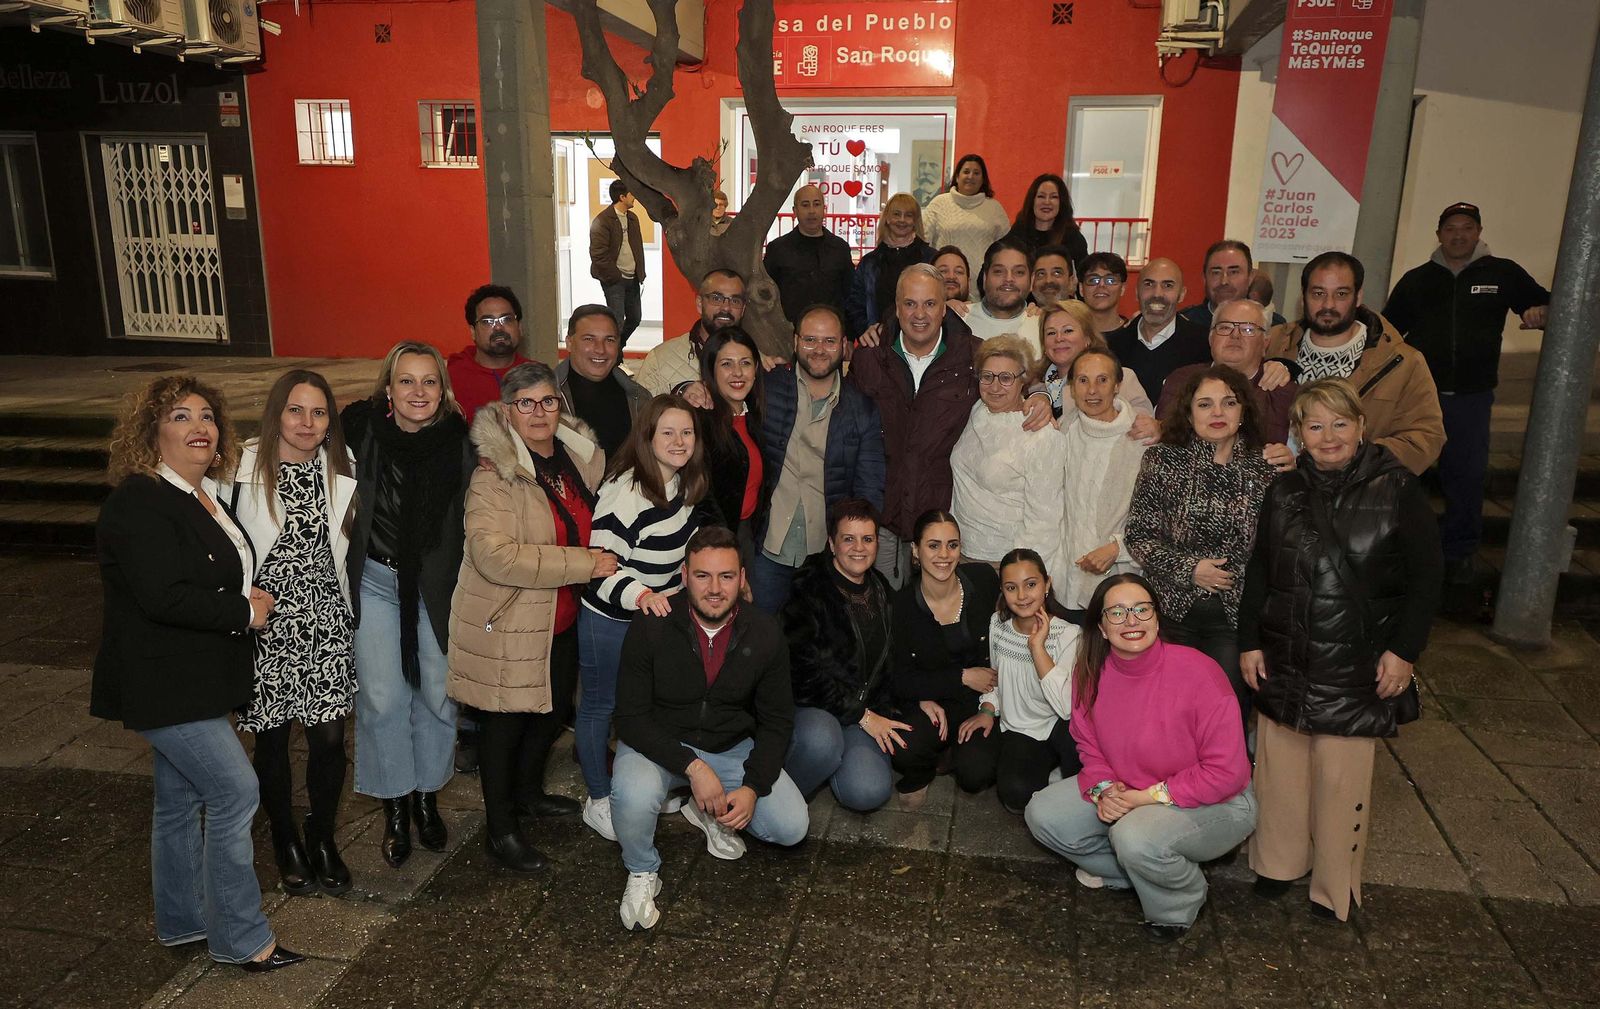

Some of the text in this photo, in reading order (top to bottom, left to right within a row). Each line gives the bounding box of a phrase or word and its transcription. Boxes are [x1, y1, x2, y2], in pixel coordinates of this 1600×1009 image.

[778, 13, 952, 32] sa del Pueblo
[1292, 29, 1373, 42] #SanRoque
[1291, 42, 1362, 55] TeQuiero
[836, 46, 946, 66] San Roqu
[1288, 56, 1365, 69] MásYMás
[95, 73, 181, 104] Luzol
[801, 125, 885, 133] SAN ROQUE ERES
[818, 139, 840, 156] TÚ
[818, 164, 851, 173] ROQUE
[1265, 189, 1316, 201] #Juan
[1263, 202, 1313, 214] Carlos
[1261, 214, 1320, 227] Alcalde
[1260, 227, 1296, 239] 2023
